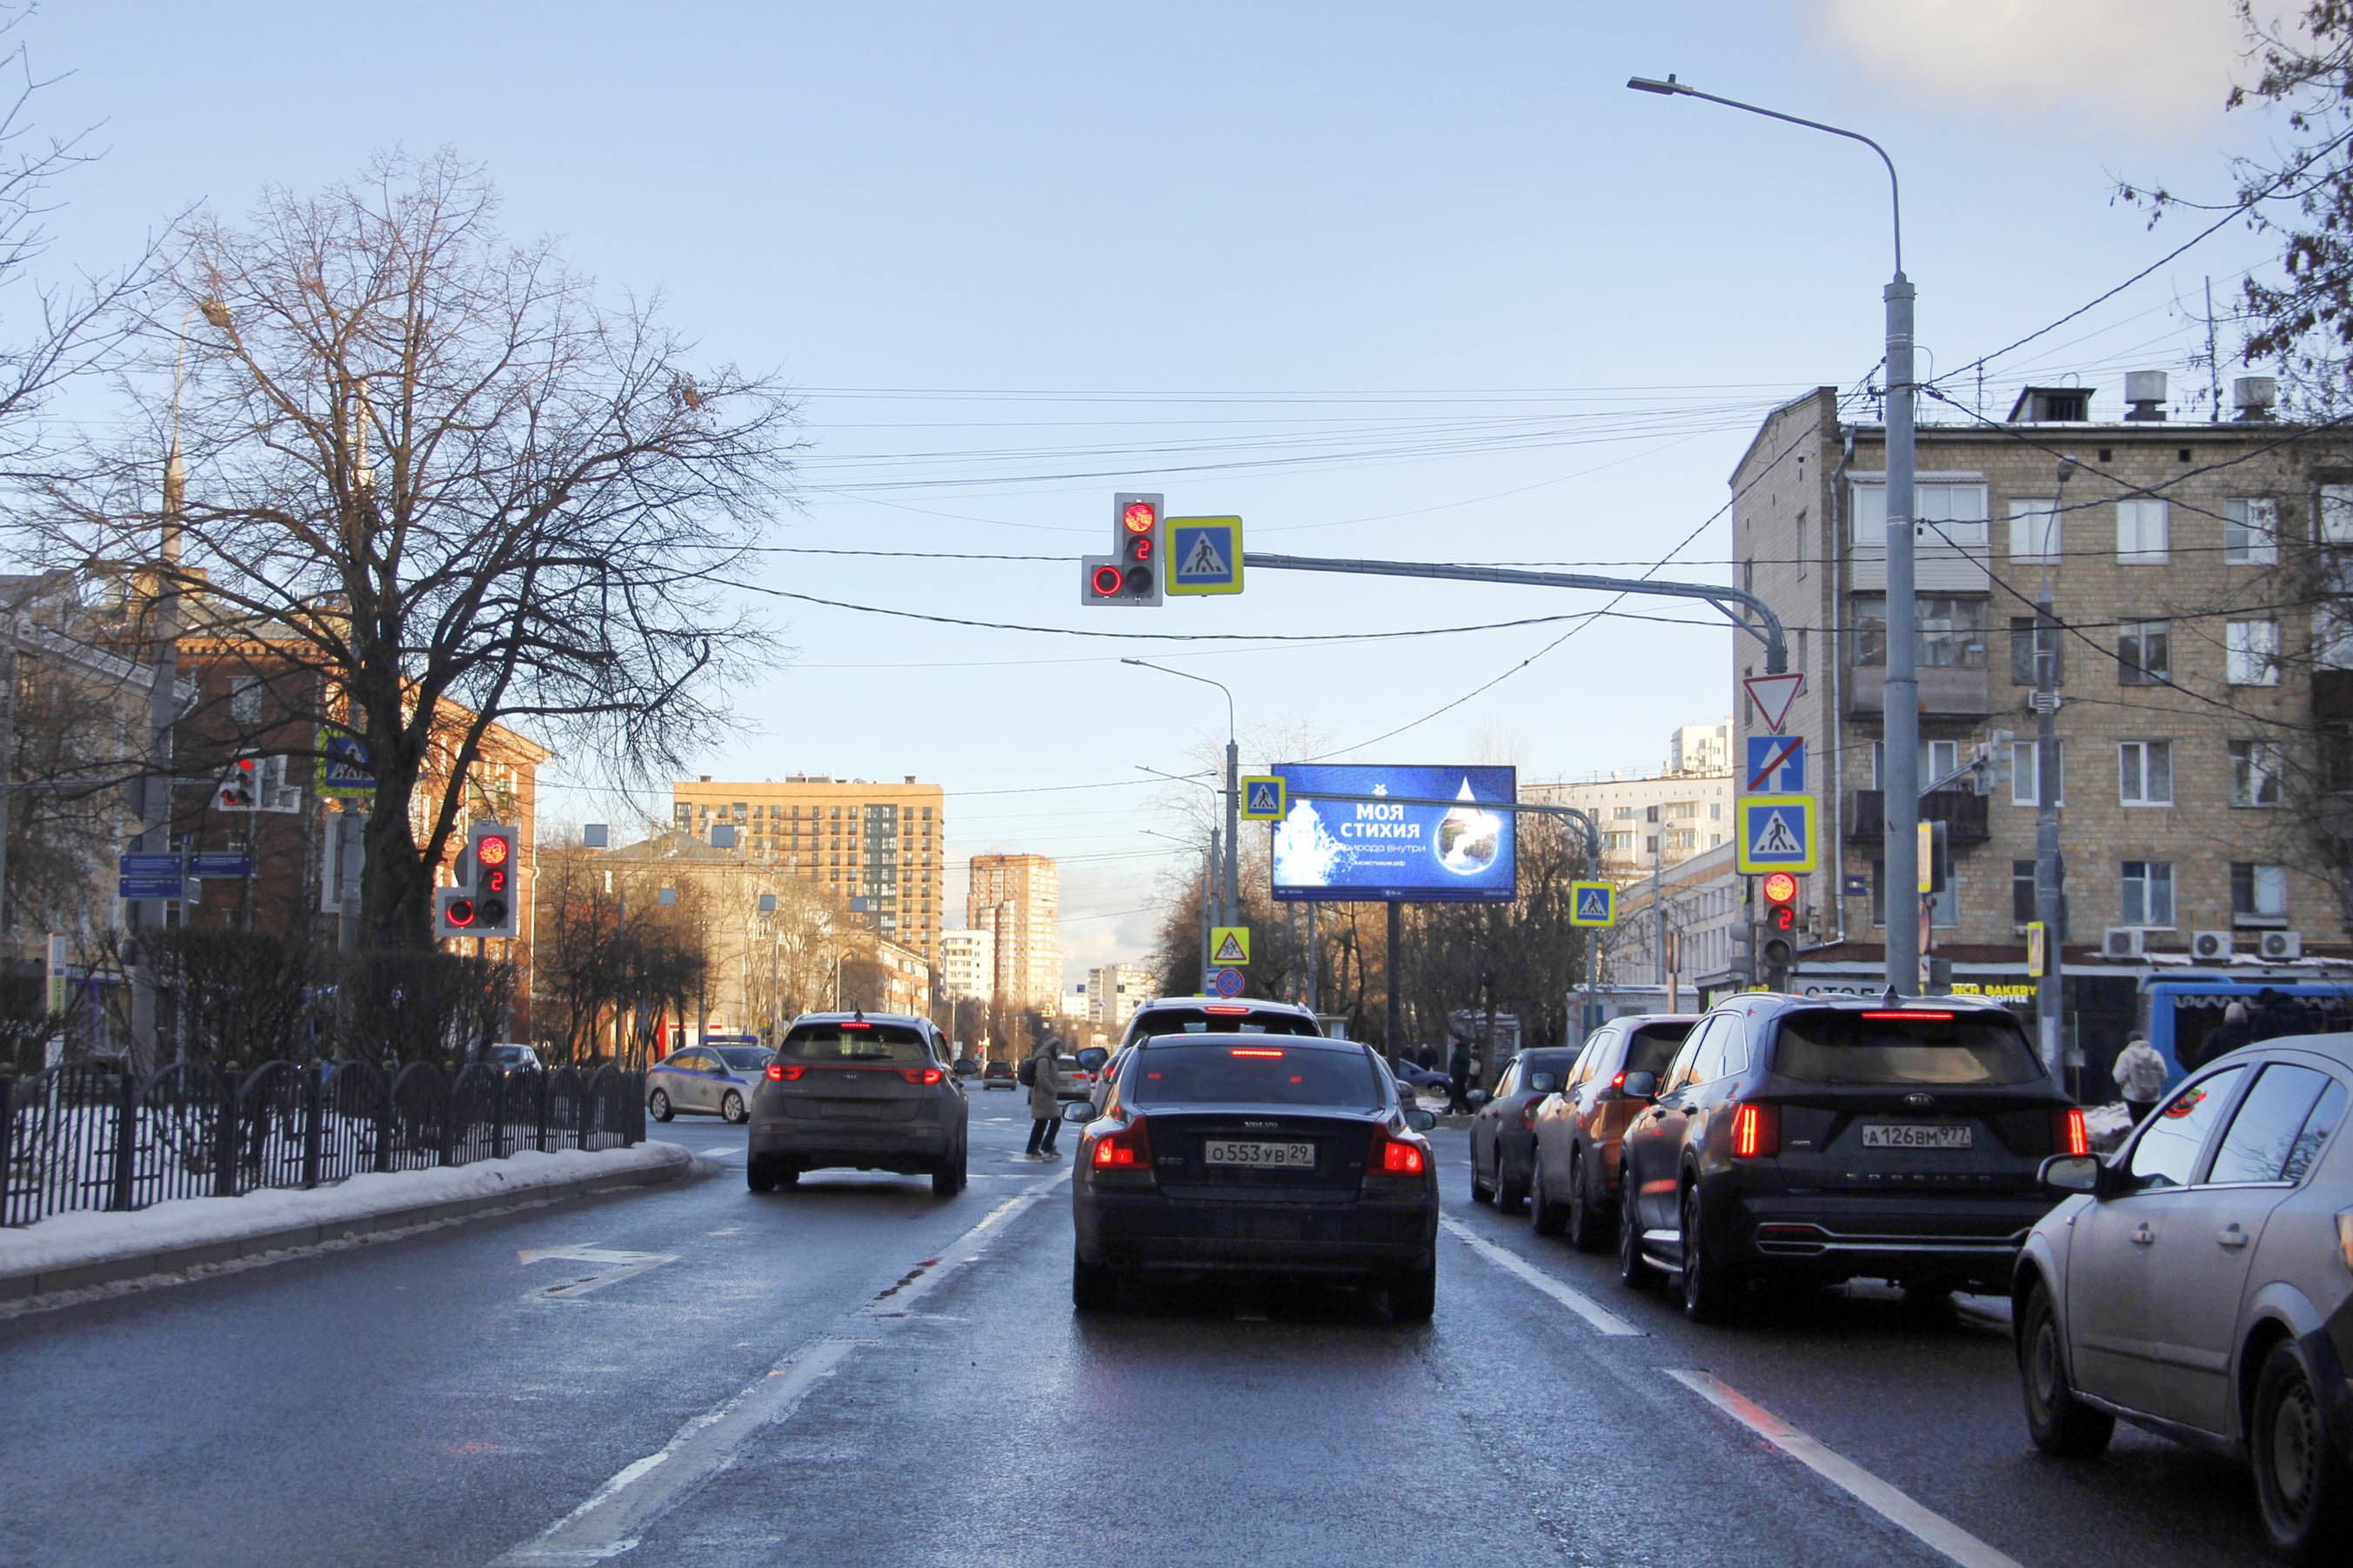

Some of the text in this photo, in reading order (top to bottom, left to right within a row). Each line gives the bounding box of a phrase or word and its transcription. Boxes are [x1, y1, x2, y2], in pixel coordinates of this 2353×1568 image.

[1356, 804, 1404, 821] МОЯ
[1340, 823, 1420, 839] СТИХИЯ
[1337, 844, 1426, 854] рирода внутри
[1985, 985, 2038, 996] BAKERY
[1941, 1127, 1967, 1141] 977
[1290, 1144, 1309, 1159] 29
